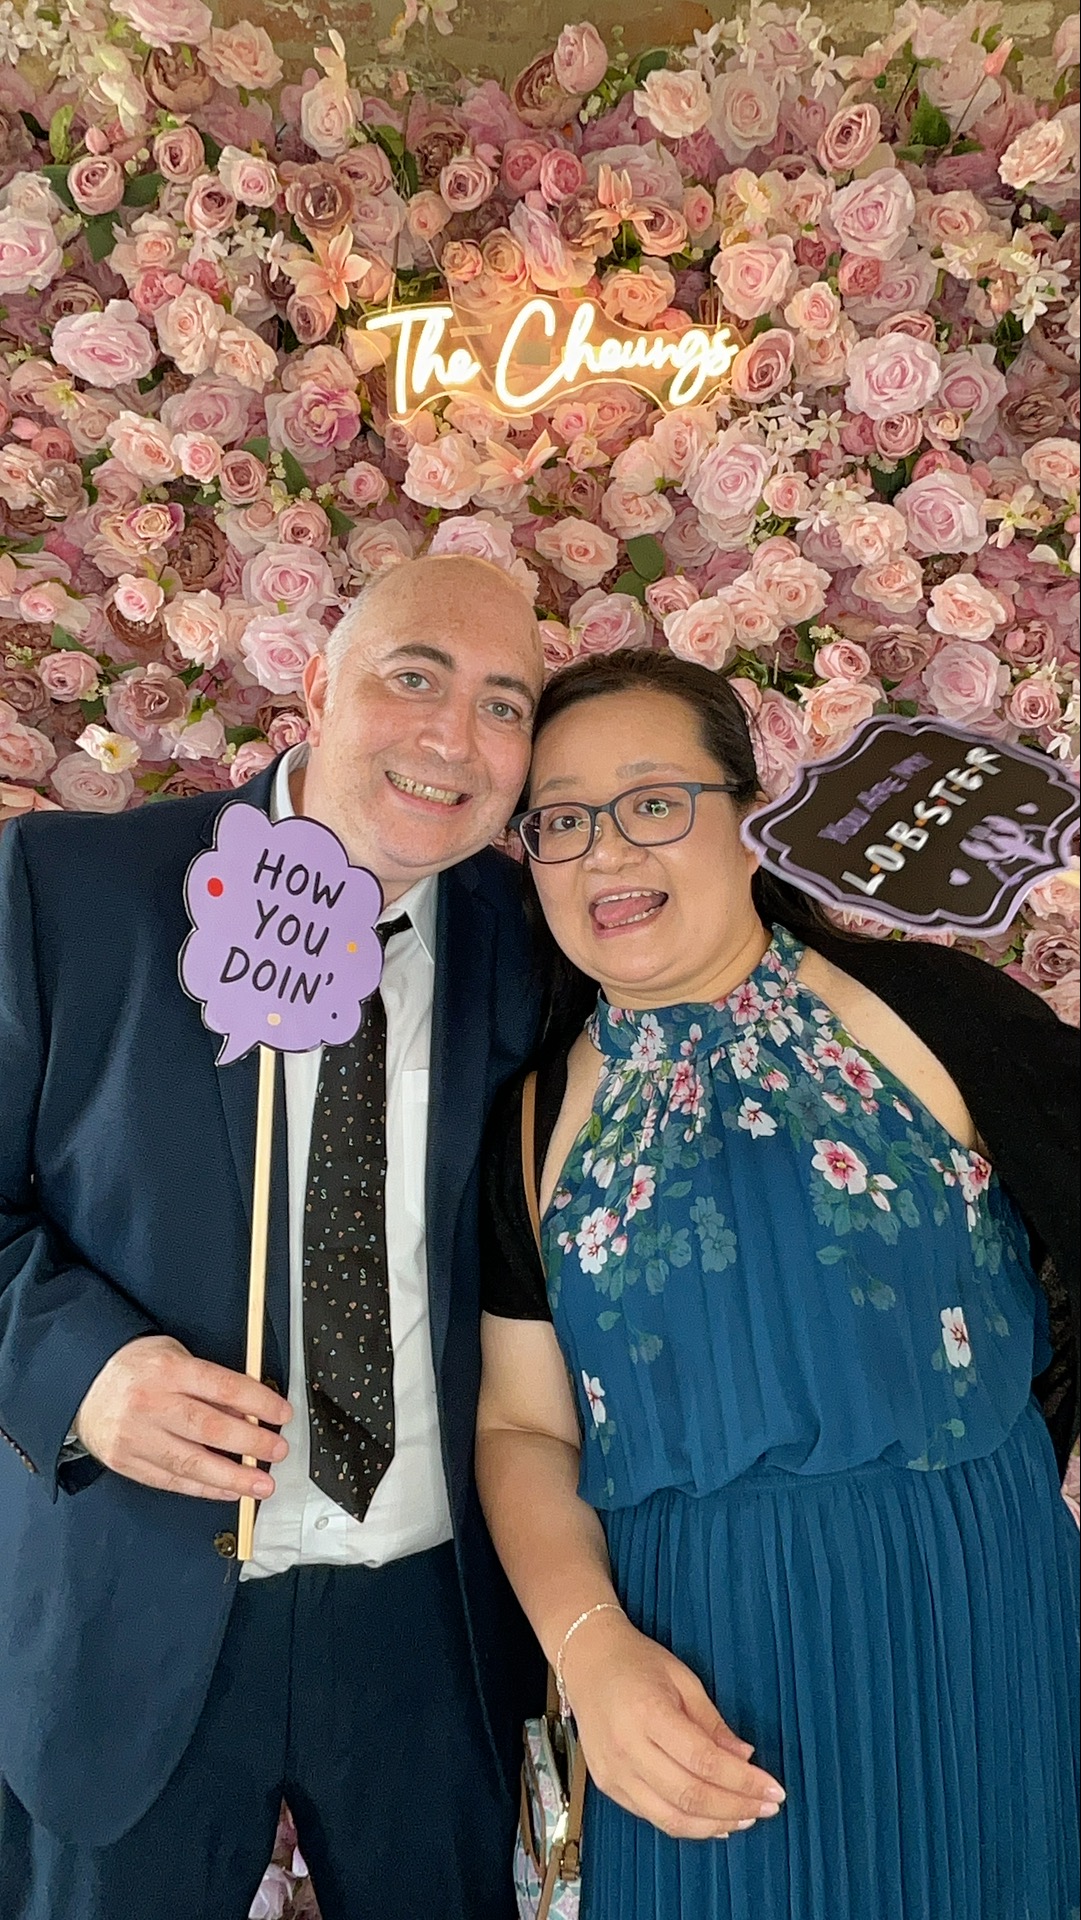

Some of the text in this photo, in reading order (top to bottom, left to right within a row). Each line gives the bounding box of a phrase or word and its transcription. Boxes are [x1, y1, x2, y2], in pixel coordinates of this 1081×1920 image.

[366, 299, 739, 415] The Cheungs
[253, 848, 346, 909] HOW
[254, 899, 329, 957] YOU
[219, 946, 334, 1004] DOIN'
